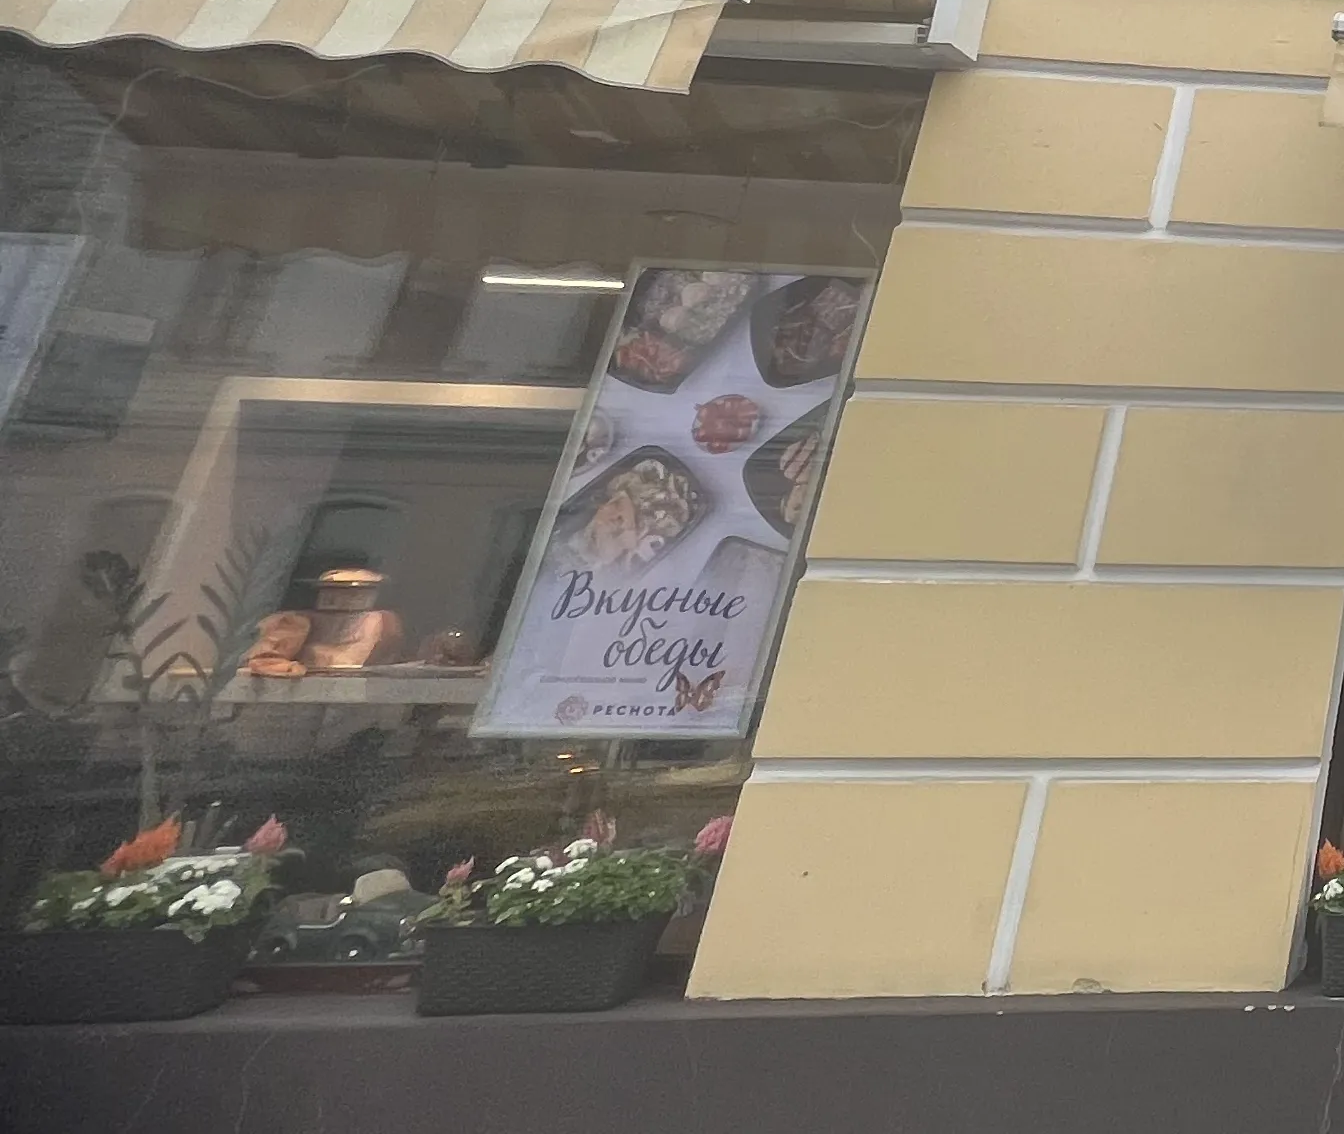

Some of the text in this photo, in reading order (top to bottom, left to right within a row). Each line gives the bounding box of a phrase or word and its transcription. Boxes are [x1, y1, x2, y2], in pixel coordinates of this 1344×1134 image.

[551, 569, 748, 638] Вкусные
[602, 617, 728, 692] обеды
[592, 704, 676, 717] РЕСНОТА
